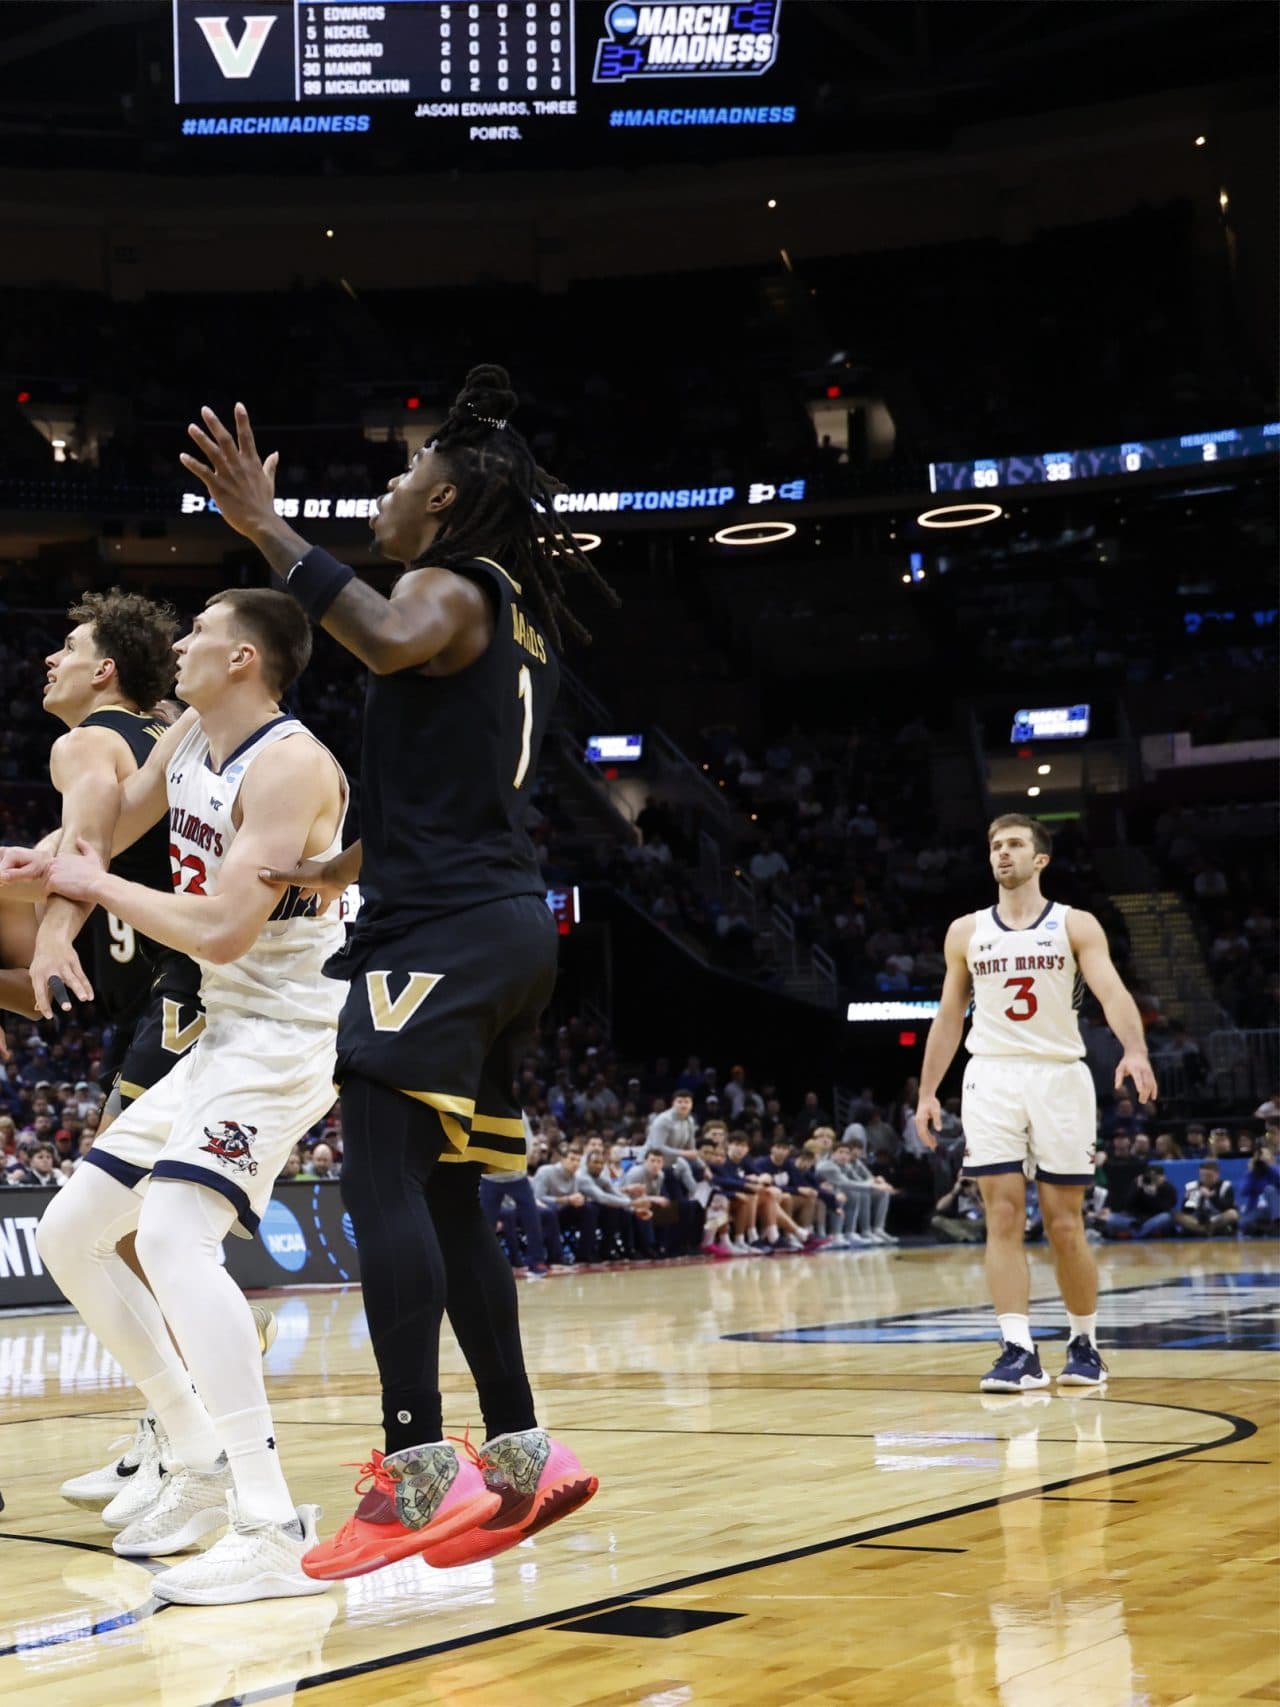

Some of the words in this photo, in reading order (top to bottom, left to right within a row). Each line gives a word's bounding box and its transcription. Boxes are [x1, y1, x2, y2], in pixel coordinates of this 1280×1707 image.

[307, 8, 316, 21] 1
[324, 6, 385, 21] EDWARDS
[440, 5, 451, 19] 5
[469, 4, 479, 18] 0
[497, 4, 508, 18] 0
[526, 3, 537, 17] 0
[550, 3, 561, 17] 0
[637, 6, 730, 36] MARCH
[307, 26, 317, 40] 5
[324, 25, 370, 39] NICKEL
[440, 23, 451, 37] 0
[469, 23, 479, 37] 0
[498, 22, 508, 36] 1
[526, 22, 537, 36] 0
[550, 21, 561, 35] 0
[194, 15, 278, 78] V
[304, 44, 320, 59] 11
[440, 41, 451, 55] 2
[469, 41, 479, 55] 0
[498, 40, 508, 55] 1
[526, 40, 537, 54] 0
[550, 39, 561, 54] 0
[648, 34, 773, 64] MADNESS
[303, 62, 321, 77] 30
[440, 60, 451, 74] 0
[469, 59, 479, 74] 0
[497, 59, 508, 73] 0
[526, 58, 537, 73] 0
[551, 58, 561, 72] 1
[303, 81, 322, 95] 99
[325, 79, 410, 94] MCGLOCKTON
[440, 78, 451, 92] 0
[469, 78, 479, 92] 2
[497, 77, 508, 91] 0
[526, 76, 537, 91] 0
[550, 76, 561, 90] 0
[415, 103, 459, 117] JASON
[533, 101, 577, 115] THREE
[610, 107, 795, 126] #MARCHMADNESS
[182, 115, 370, 135] #MARCHMADNESS
[470, 126, 522, 141] POINTS.
[974, 469, 998, 487] 50
[1046, 462, 1071, 481] 33
[1126, 453, 1140, 471] 0
[1202, 442, 1217, 461] 2
[554, 487, 735, 513] CHAMPIONSHIP
[513, 663, 533, 790] 1
[973, 958, 1009, 976] SAINT
[1015, 953, 1066, 971] MARY'S
[365, 970, 446, 1032] V
[1003, 976, 1038, 1021] 3
[162, 997, 208, 1055] V
